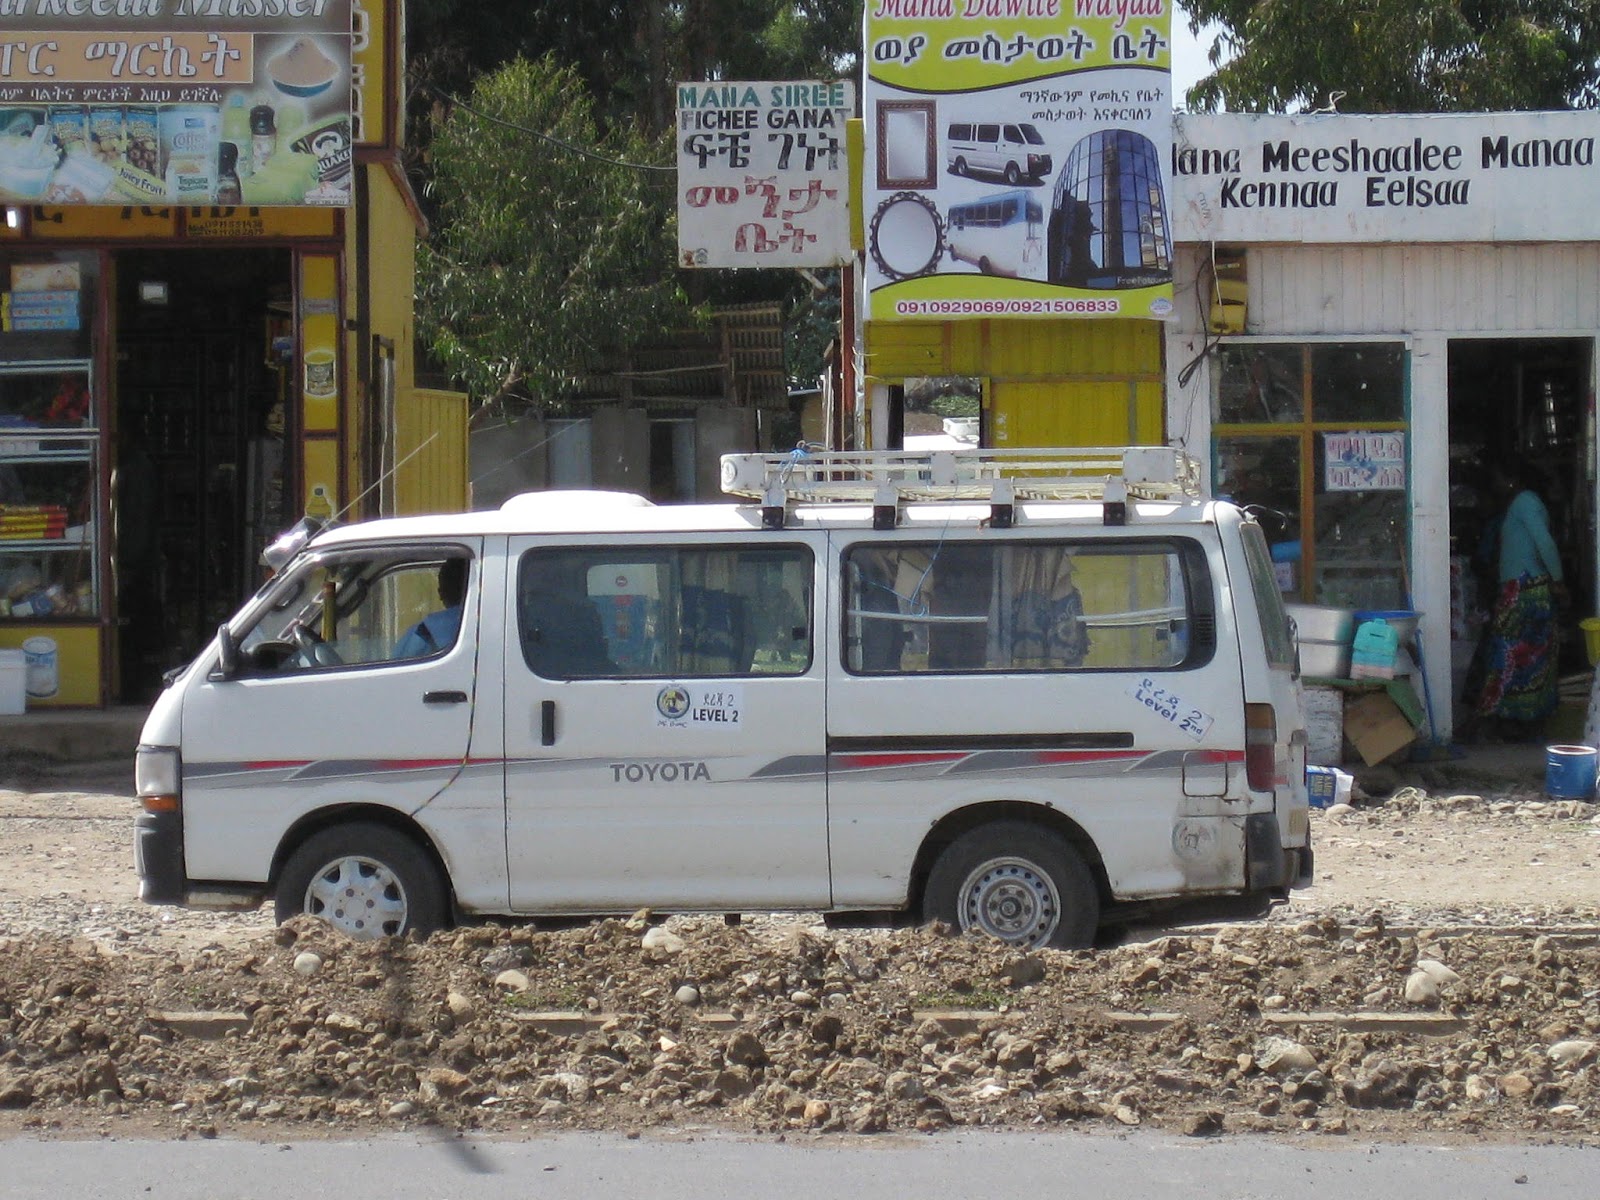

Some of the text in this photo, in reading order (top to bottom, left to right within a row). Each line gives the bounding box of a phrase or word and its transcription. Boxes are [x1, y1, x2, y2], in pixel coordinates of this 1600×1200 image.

[85, 33, 241, 77] ማርኬት
[874, 28, 1167, 63] ወያ መስታወት ቤት
[679, 84, 844, 108] MANA SIREE
[681, 110, 759, 130] FICHEE
[768, 132, 846, 171] ገነት
[1171, 135, 1595, 176] ana Meeshaalee Manaa
[686, 175, 838, 220] መኝታ
[1221, 177, 1339, 208] Kennaa
[1366, 176, 1471, 207] Eelsaa
[735, 223, 817, 253] ቤት
[896, 301, 1119, 313] 0910929069/0921506833
[693, 708, 739, 723] LEVEL 2
[727, 694, 734, 707] 2
[1135, 689, 1203, 735] Level 2nd
[1188, 710, 1203, 725] 2
[610, 762, 711, 782] TOYOTA
